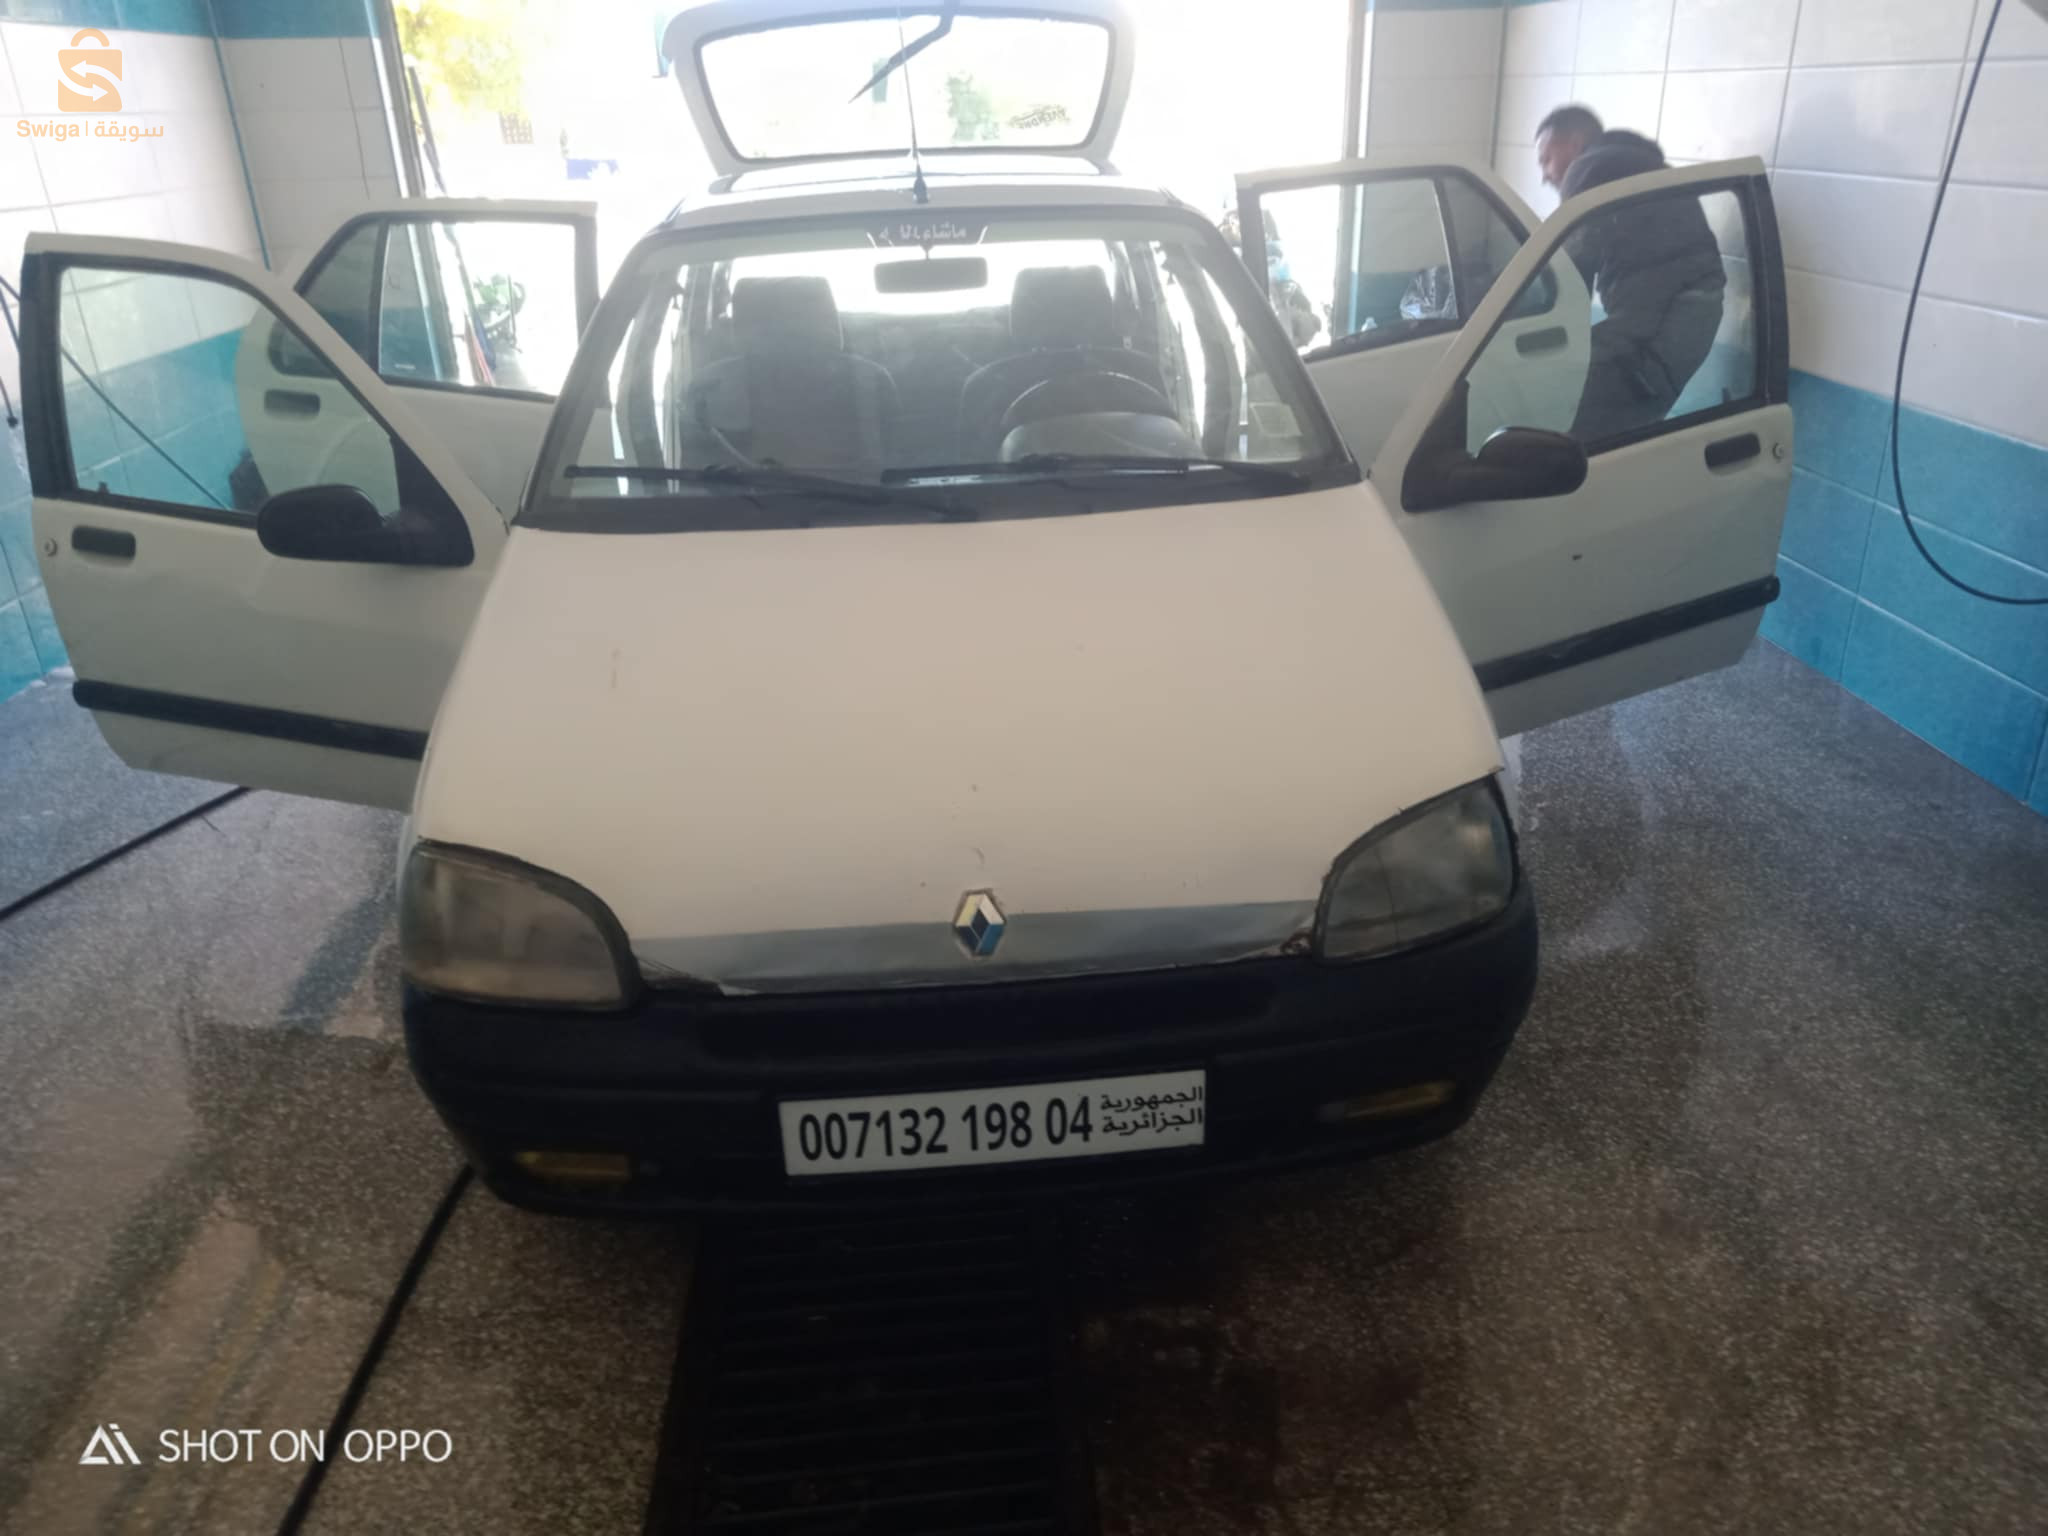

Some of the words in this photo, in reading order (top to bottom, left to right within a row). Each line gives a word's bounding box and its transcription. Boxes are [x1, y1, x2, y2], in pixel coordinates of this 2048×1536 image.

[1101, 1086, 1203, 1113] الجمهورية
[799, 1106, 948, 1161] 007132
[961, 1100, 1032, 1151] 198
[1045, 1096, 1093, 1145] 04
[1103, 1107, 1203, 1136] الجزائرية
